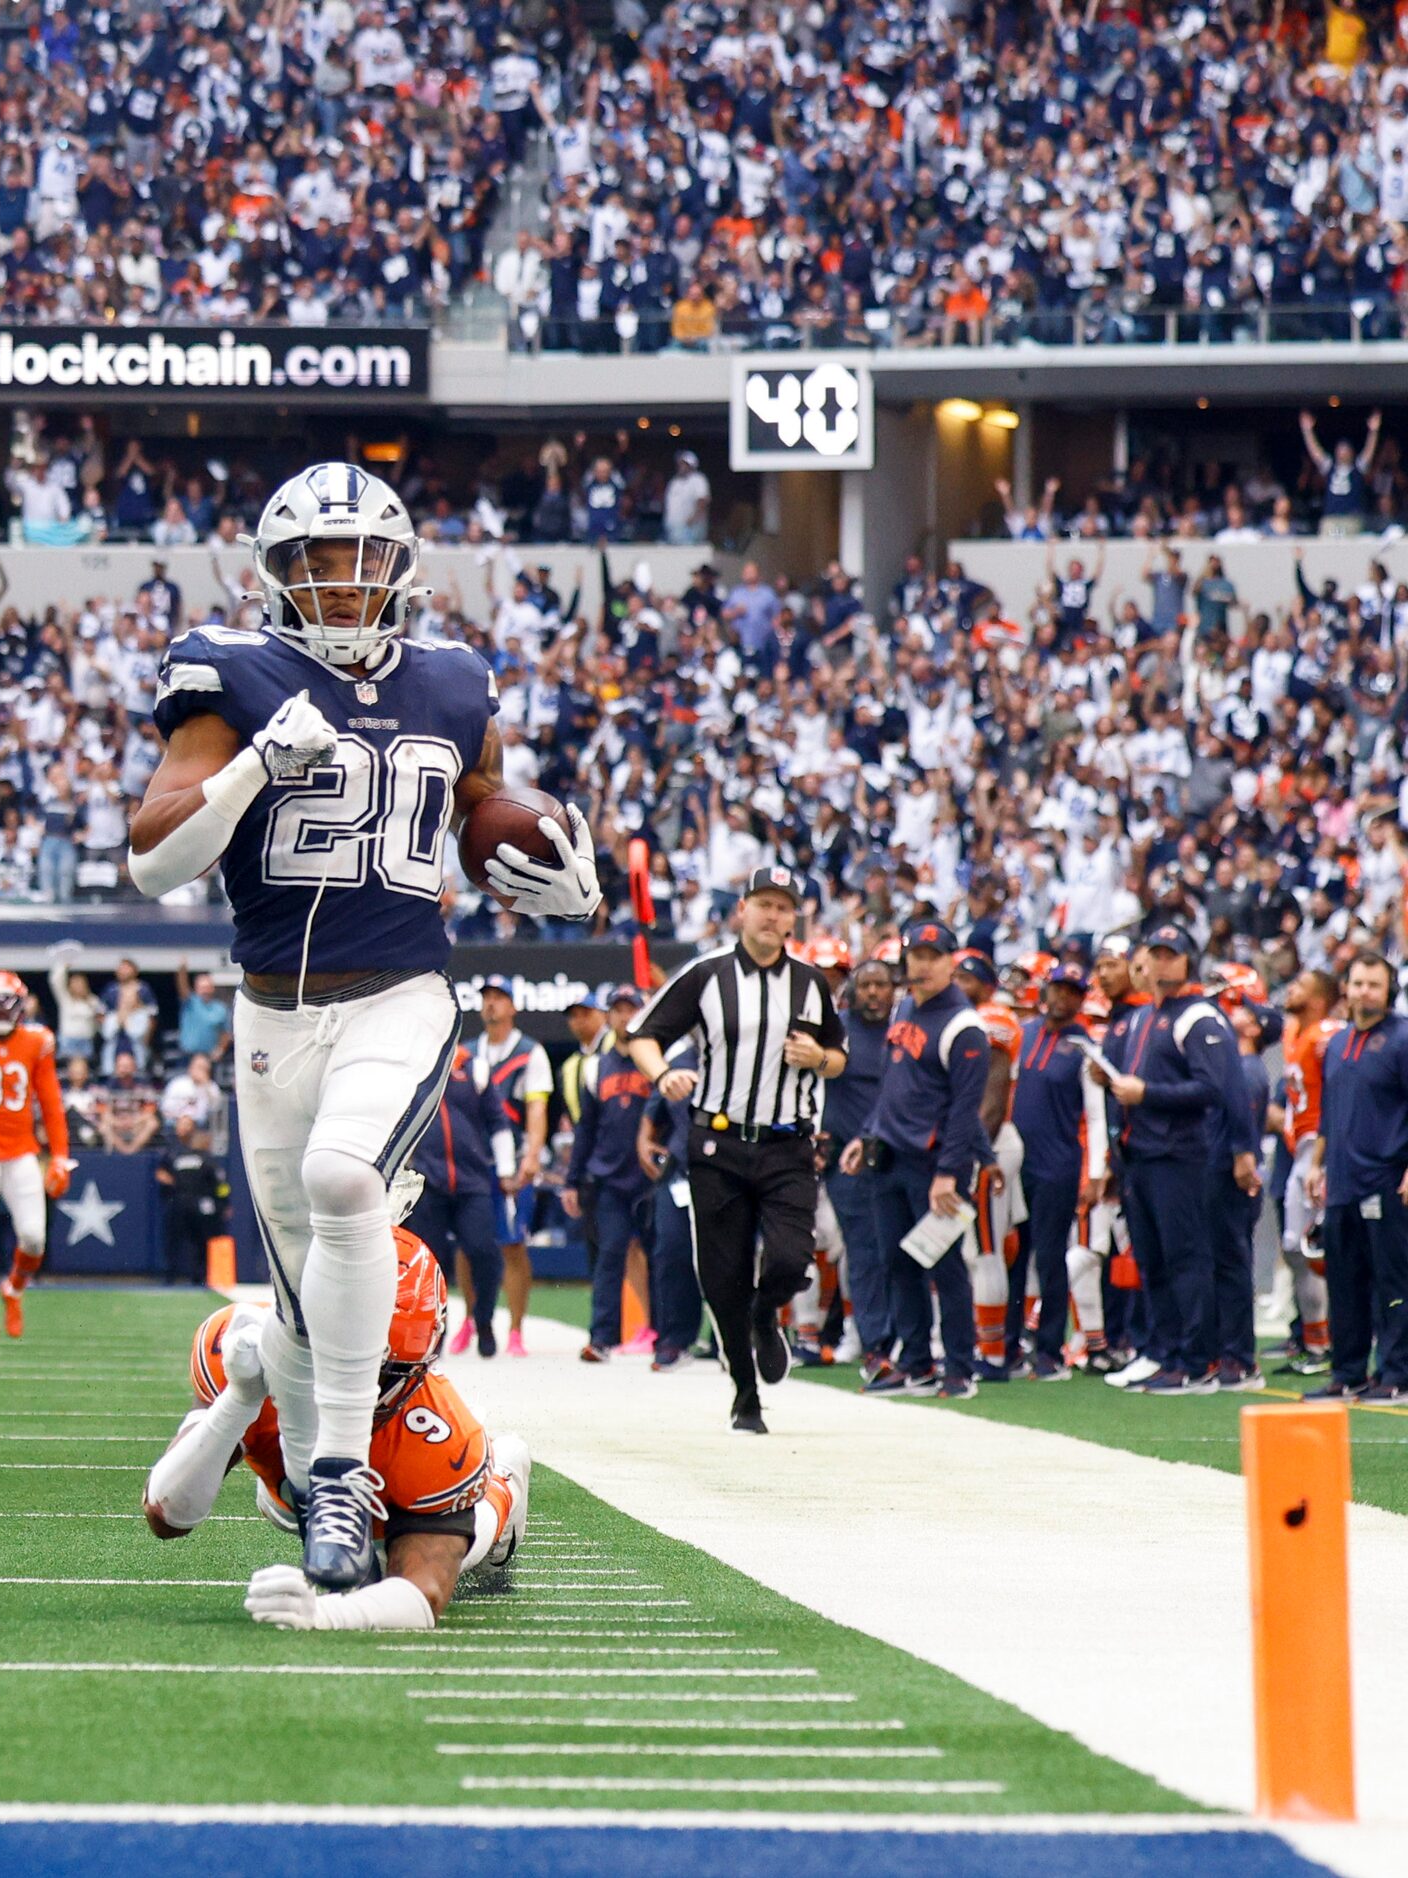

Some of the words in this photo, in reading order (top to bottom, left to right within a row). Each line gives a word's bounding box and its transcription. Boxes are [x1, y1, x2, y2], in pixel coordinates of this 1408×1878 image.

[746, 362, 859, 456] 40
[261, 733, 464, 902] 20
[405, 1405, 453, 1444] 9
